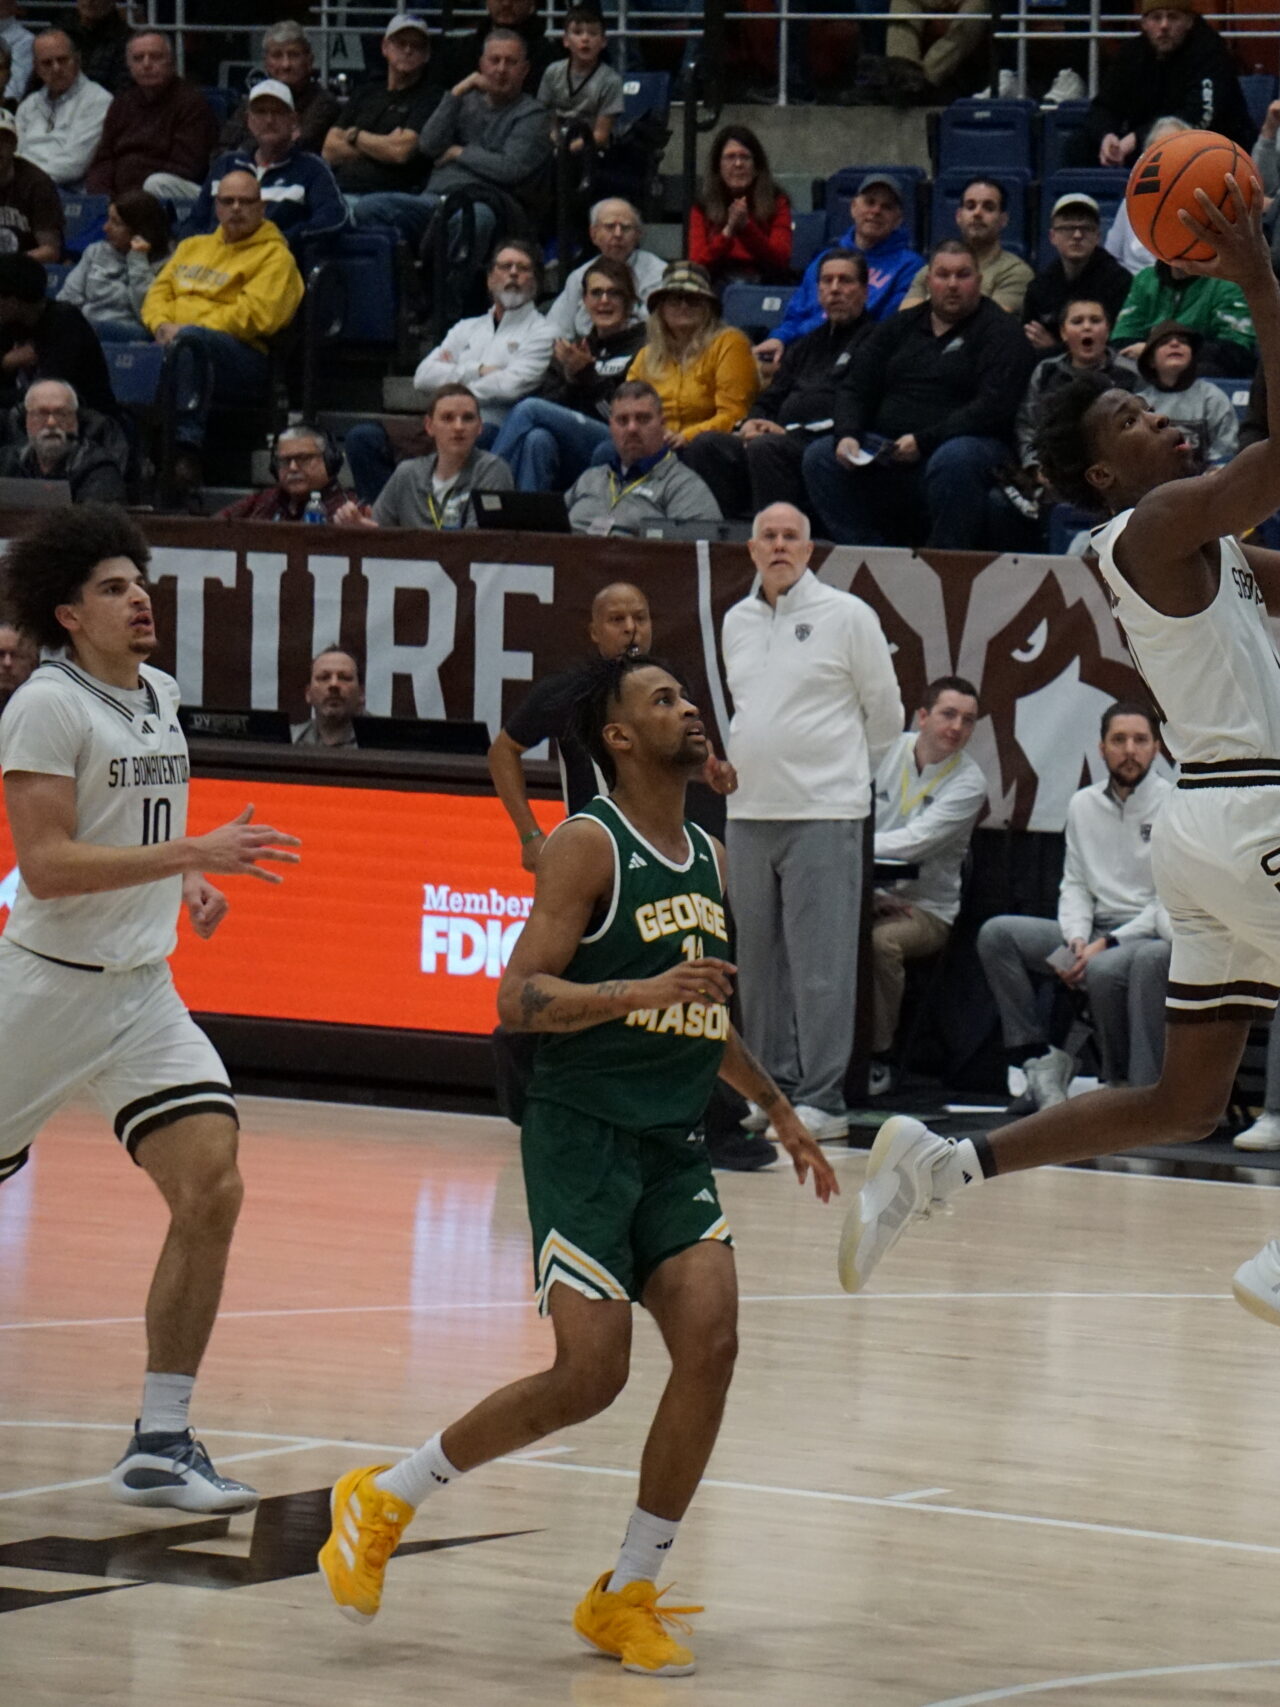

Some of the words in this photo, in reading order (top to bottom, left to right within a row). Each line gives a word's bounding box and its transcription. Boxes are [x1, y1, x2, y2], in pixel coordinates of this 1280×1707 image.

[142, 797, 171, 846] 10
[422, 883, 535, 918] Member
[634, 892, 729, 943] GEORGE
